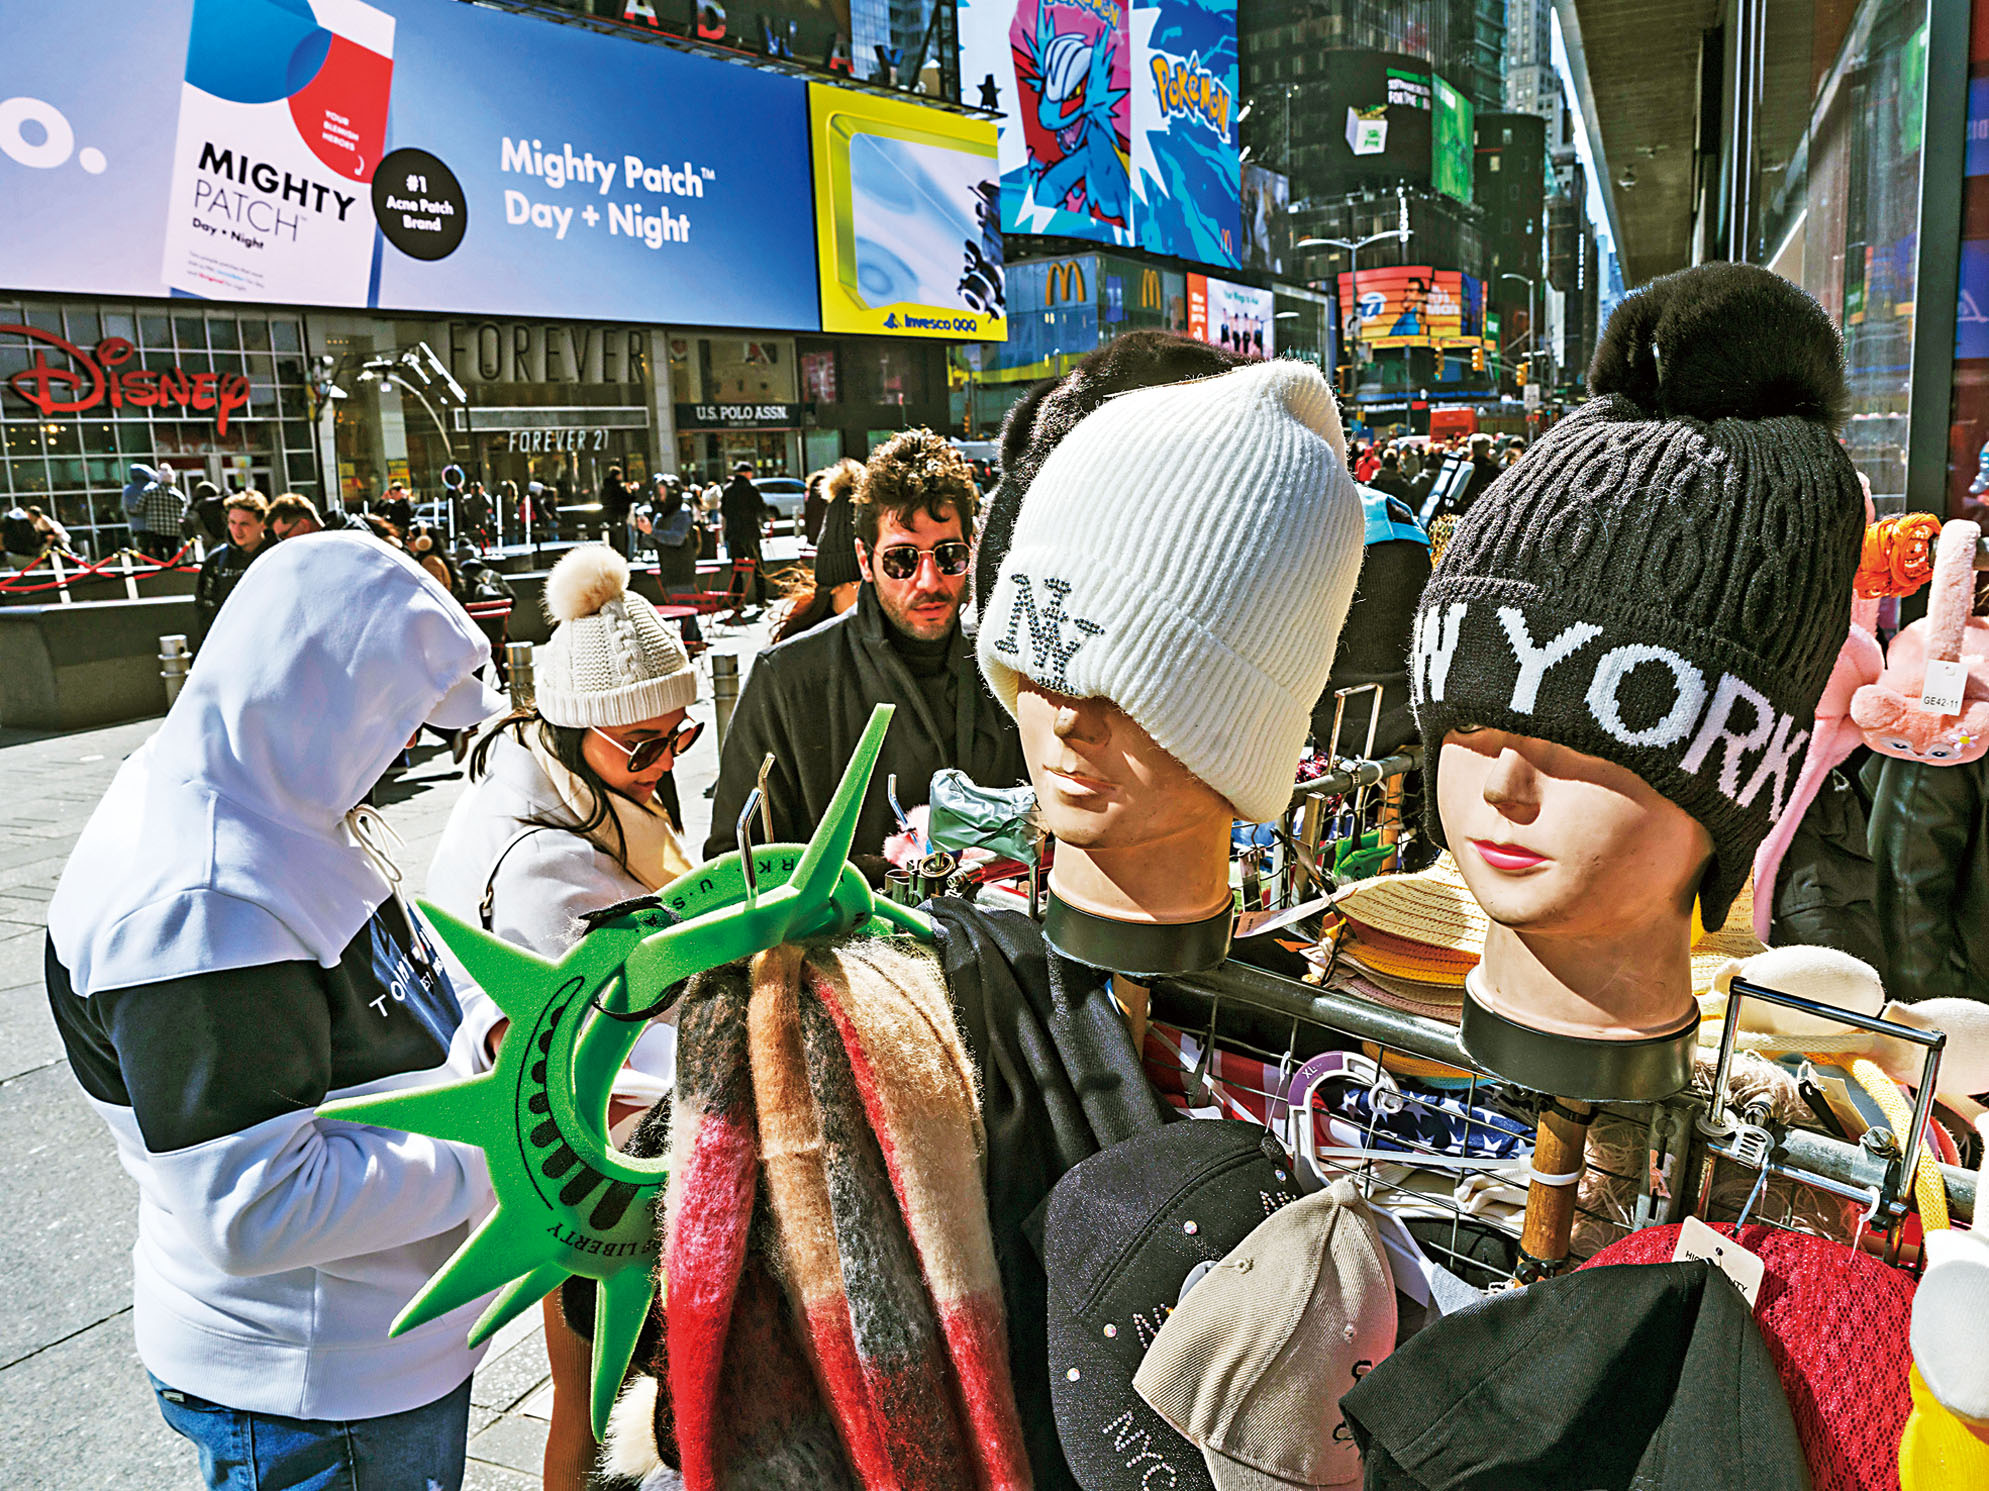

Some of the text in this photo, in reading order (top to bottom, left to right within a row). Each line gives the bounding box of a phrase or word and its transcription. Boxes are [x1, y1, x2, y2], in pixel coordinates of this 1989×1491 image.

[501, 136, 617, 195] Mighty
[199, 141, 356, 221] MIGHTY
[406, 174, 427, 193] #1
[386, 195, 454, 215] Acne Patch
[192, 217, 264, 249] Day Night
[402, 214, 442, 231] Brand
[504, 189, 573, 240] Day
[607, 202, 690, 250] Night
[904, 313, 977, 333] Invesco QQQ
[449, 321, 646, 384] FOREVER
[720, 405, 753, 420] POLO
[755, 405, 789, 420] ASSN.
[509, 429, 609, 453] FOREVER 21
[1496, 604, 1809, 823] YORK
[1302, 1065, 1318, 1079] XL
[547, 1222, 638, 1257] LIBERTY
